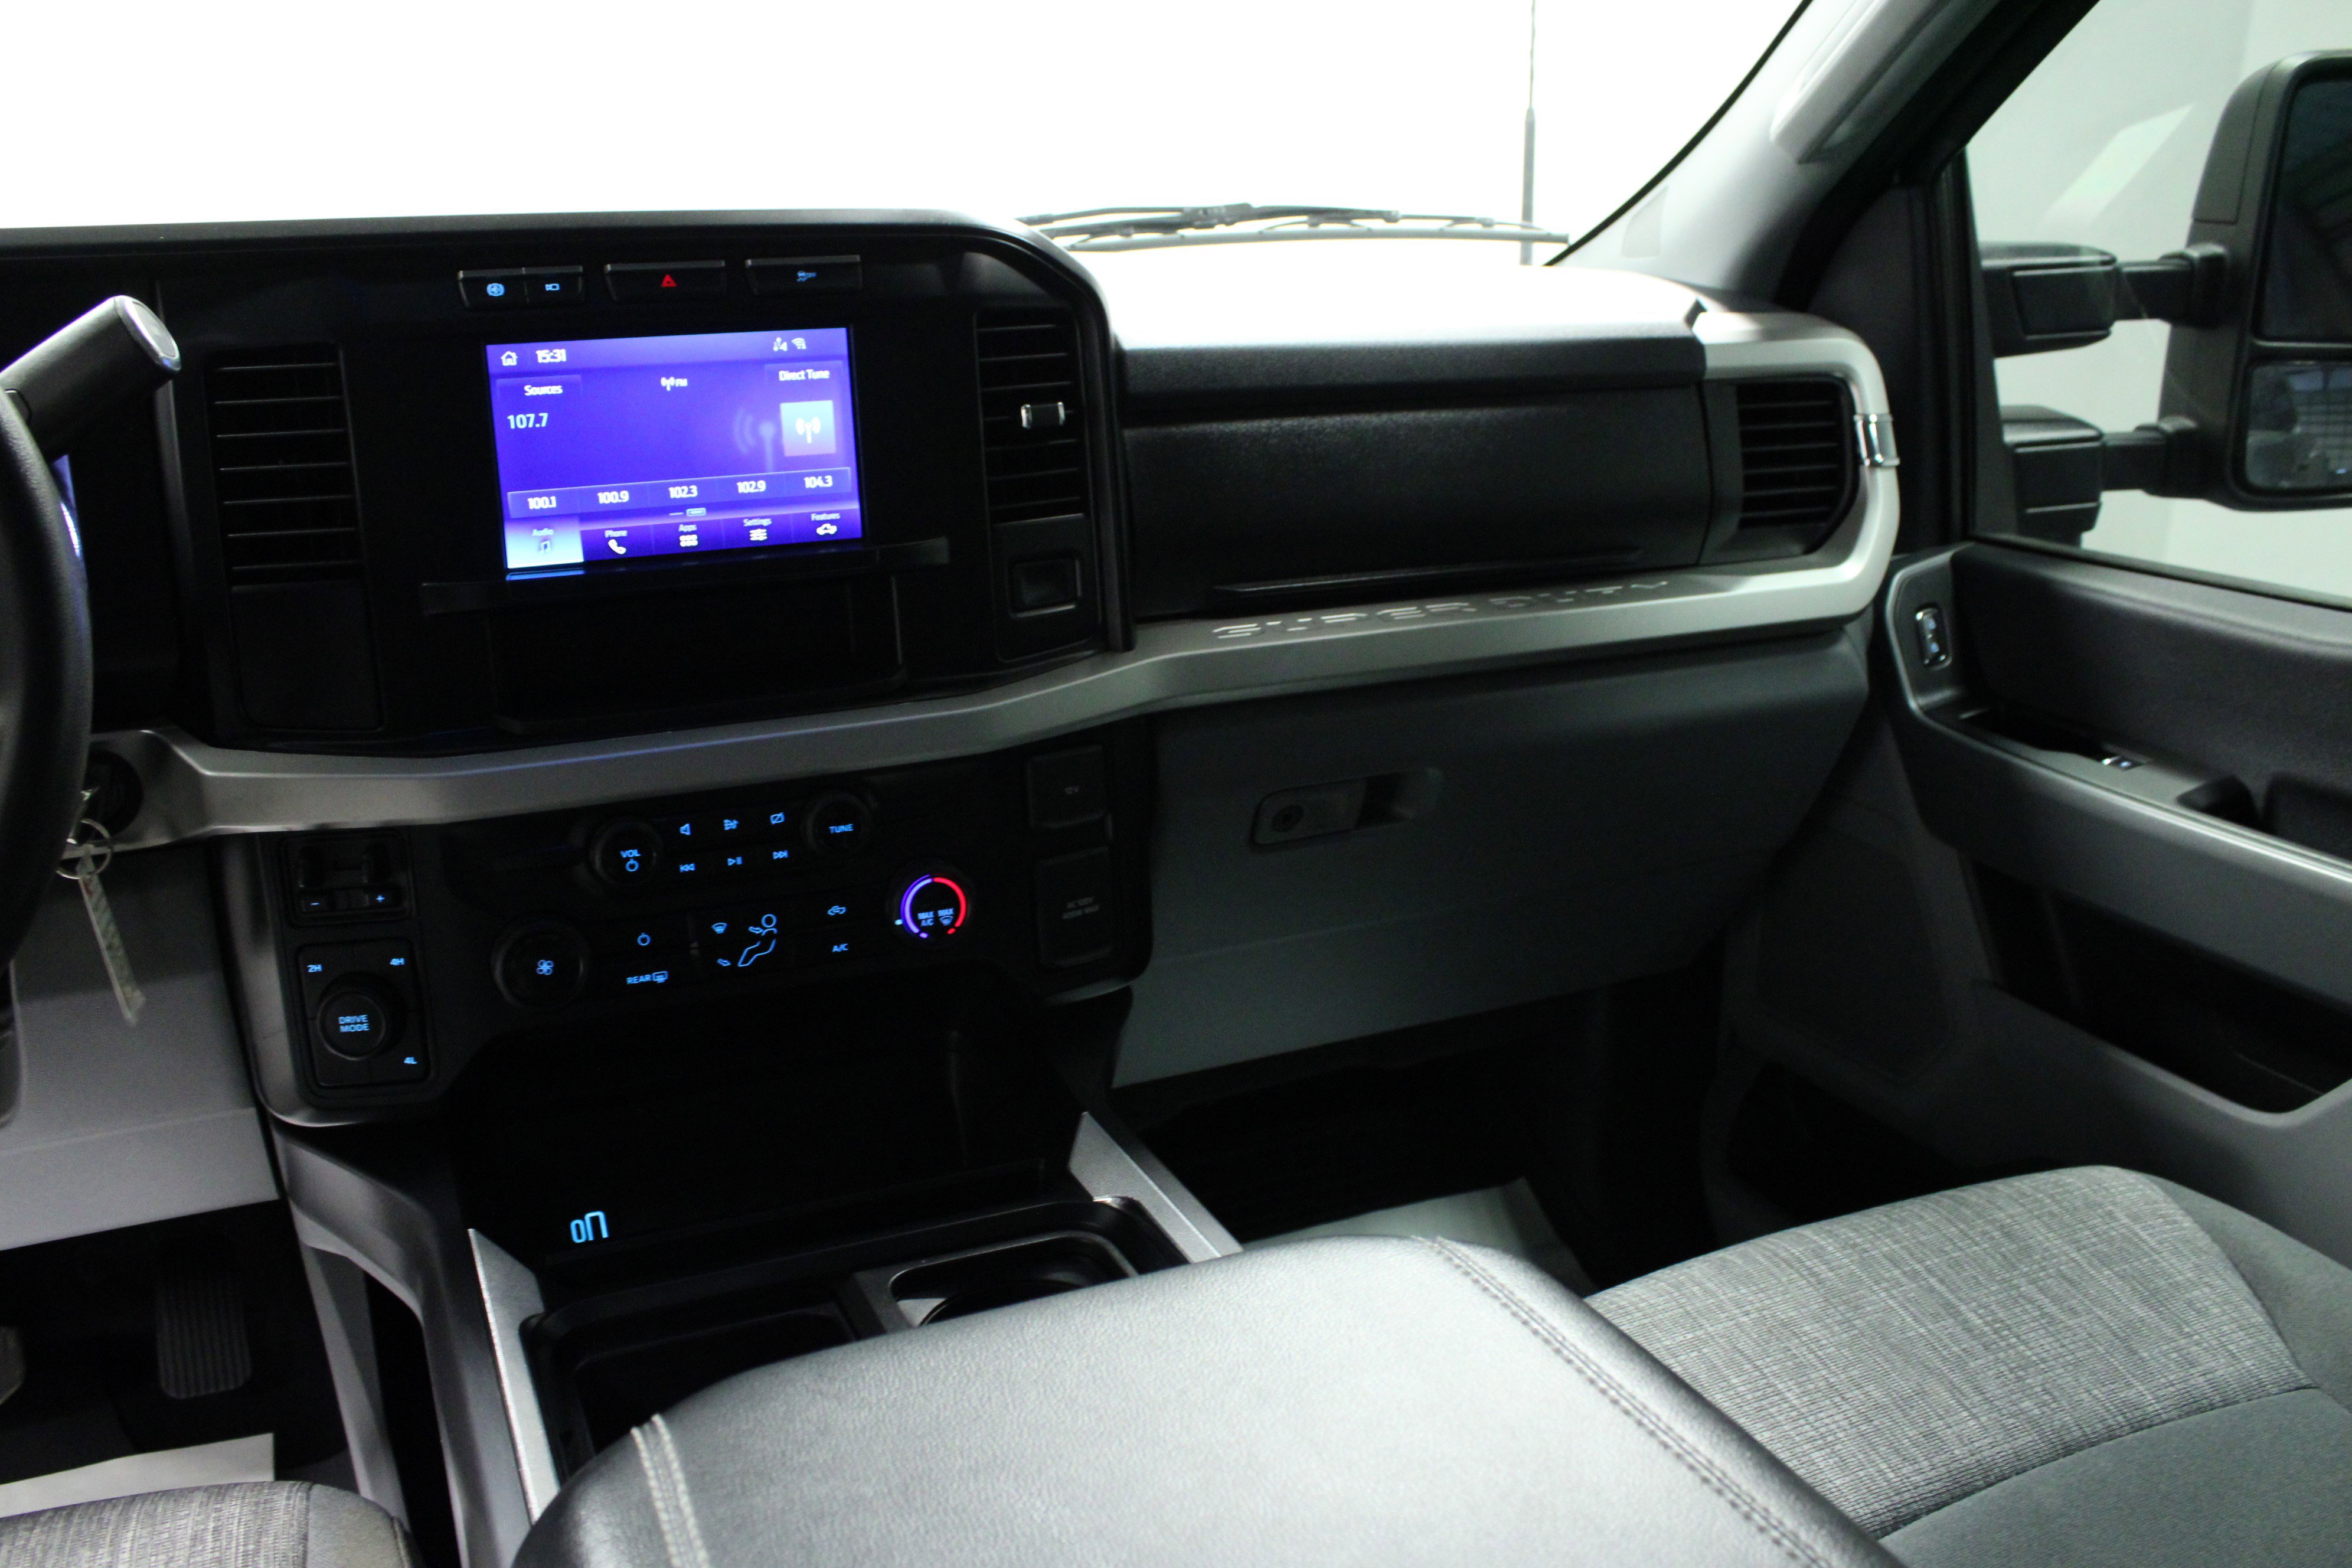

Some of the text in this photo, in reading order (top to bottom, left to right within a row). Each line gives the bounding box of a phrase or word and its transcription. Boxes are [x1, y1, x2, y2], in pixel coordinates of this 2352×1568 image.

[535, 348, 567, 364] 15:31
[779, 369, 830, 381] Direct Tune
[524, 385, 563, 396] Sources
[507, 413, 548, 429] 107.7
[737, 480, 766, 494] 102.9
[803, 475, 833, 488] 104.3
[668, 485, 698, 498] 102.3
[527, 496, 557, 509] 100.1
[597, 491, 629, 504] 100.9
[604, 530, 628, 538] Phone
[828, 824, 854, 834] TUNE
[620, 849, 641, 858] VOL
[832, 943, 849, 952] A/C
[307, 964, 322, 972] 2H
[626, 974, 652, 985] REAR
[338, 1015, 368, 1024] DRIVE
[339, 1023, 370, 1033] MODE
